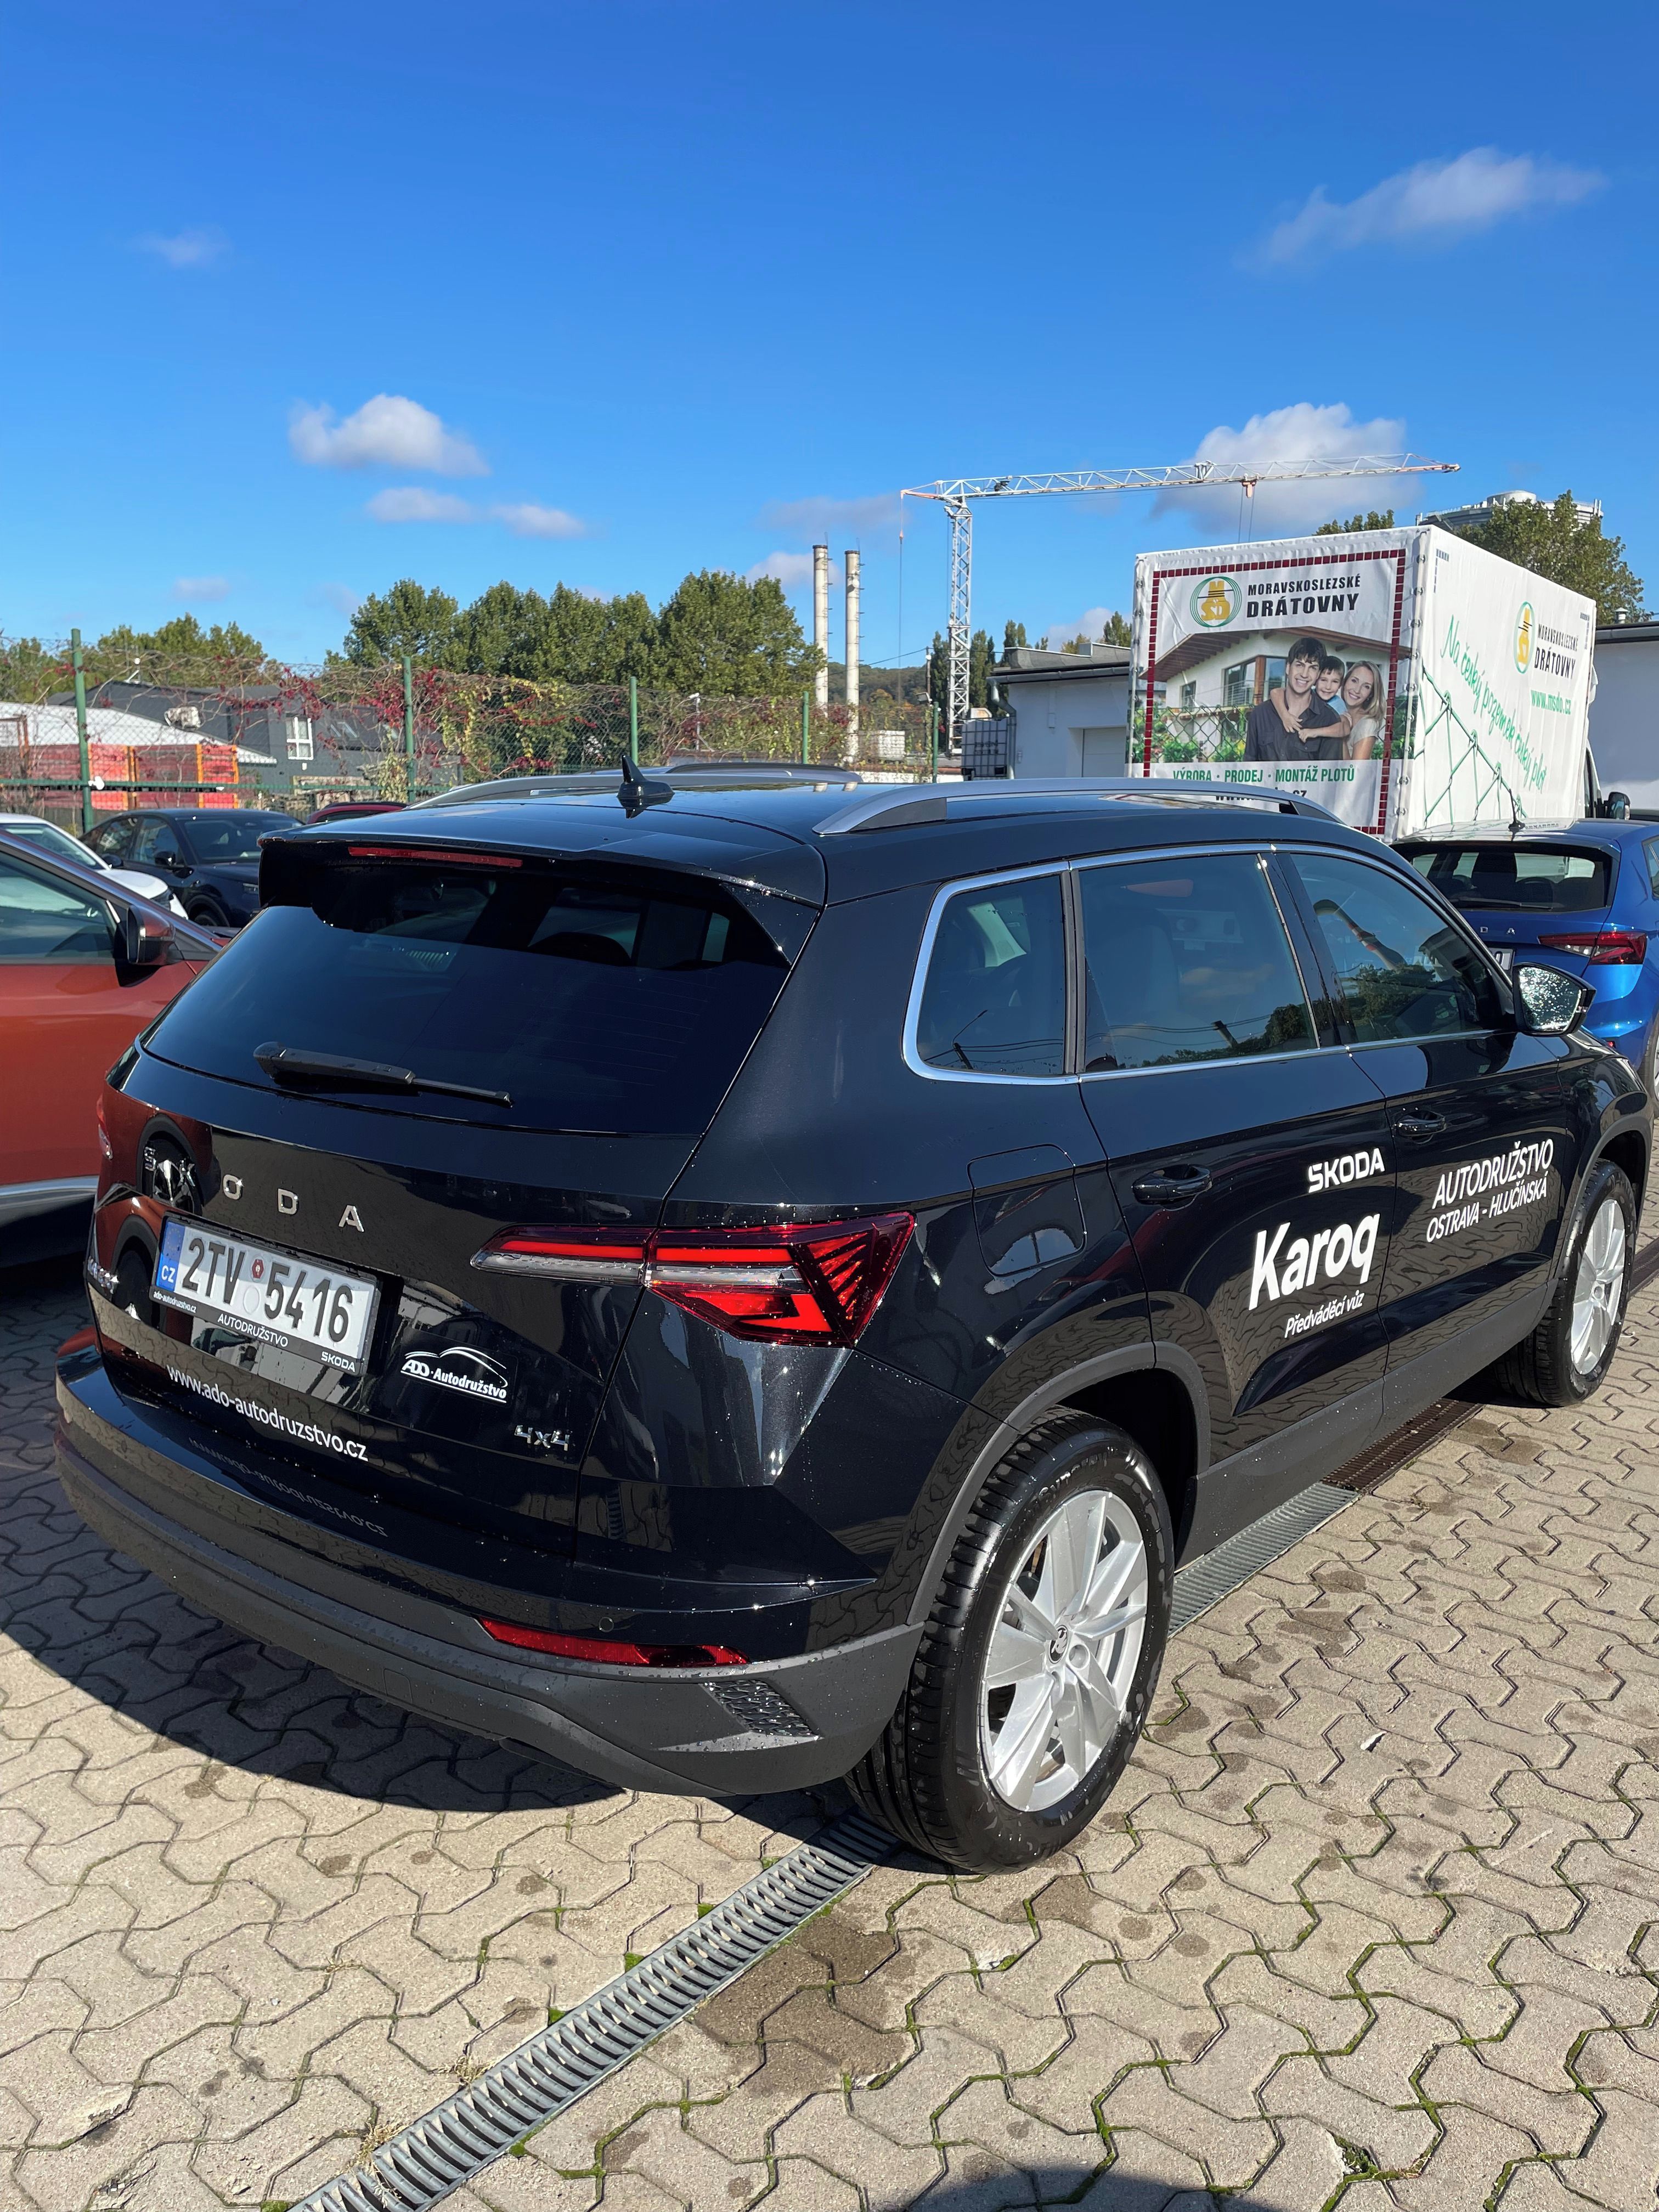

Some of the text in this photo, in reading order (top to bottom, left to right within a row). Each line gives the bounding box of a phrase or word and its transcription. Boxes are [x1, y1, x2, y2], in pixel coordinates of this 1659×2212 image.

[1248, 573, 1361, 596] MORAVSKOSLEZSKÉ
[1246, 592, 1359, 618] DRÁTOVNY
[1440, 614, 1460, 668] Na
[1537, 623, 1579, 652] MORAVSKOSLEZSKÉ
[1534, 646, 1576, 680] DRÁTOVNY
[1224, 769, 1263, 782] PRODEJ
[1275, 765, 1318, 782] MONTÁŽ
[1321, 764, 1355, 782] PLOTŮ
[1432, 1138, 1554, 1210] AUTODRUŽSTVO
[1426, 1201, 1480, 1243] OSTRAVA
[1488, 1170, 1549, 1218] HLUČÍNSKÁ
[161, 1265, 175, 1283] CZ
[1248, 1213, 1380, 1311] Karoq
[153, 1290, 198, 1313] ado-autodruzstvo.cz
[182, 1238, 246, 1305] 2TV
[264, 1261, 354, 1343] 5416
[217, 1312, 289, 1348] AUTODRUŽSTVO
[1284, 1290, 1365, 1339] Předváděcí vůz
[166, 1364, 369, 1462] www.ado-autodruzstvo.cz
[514, 1425, 571, 1452] 4x4
